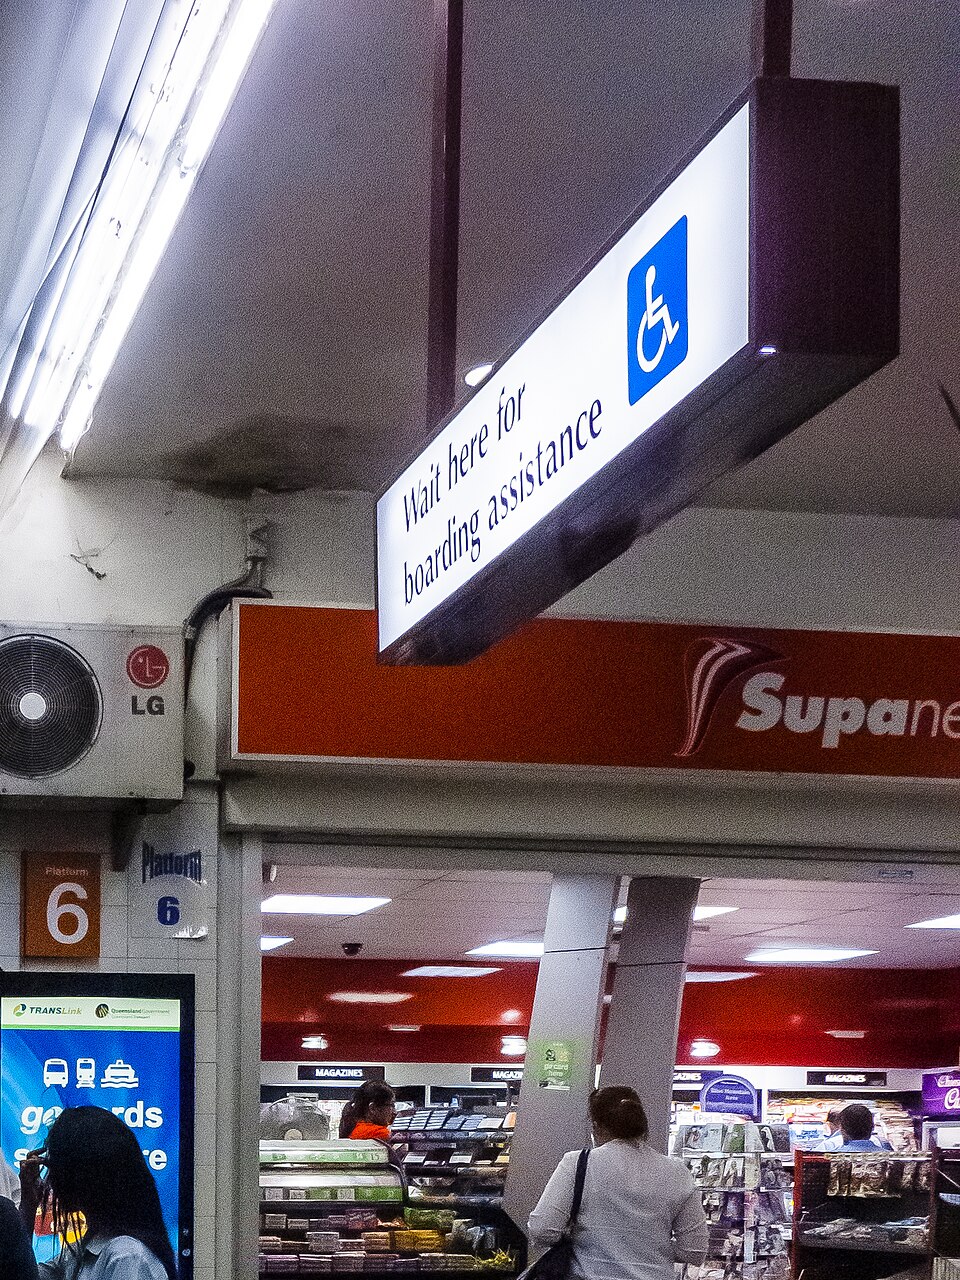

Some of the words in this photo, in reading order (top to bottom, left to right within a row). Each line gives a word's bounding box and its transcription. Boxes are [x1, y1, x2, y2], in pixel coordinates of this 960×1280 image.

[403, 461, 441, 533] Wait
[448, 423, 489, 491] here
[496, 382, 526, 442] for
[403, 509, 481, 607] boarding
[487, 398, 603, 531] assistance
[131, 695, 165, 716] LG
[45, 865, 89, 877] Platform
[141, 843, 202, 885] Platform
[45, 881, 89, 945] 6
[156, 895, 181, 926] 6
[315, 1068, 363, 1077] MAGAZINES
[825, 1074, 867, 1083] MAGAZINES
